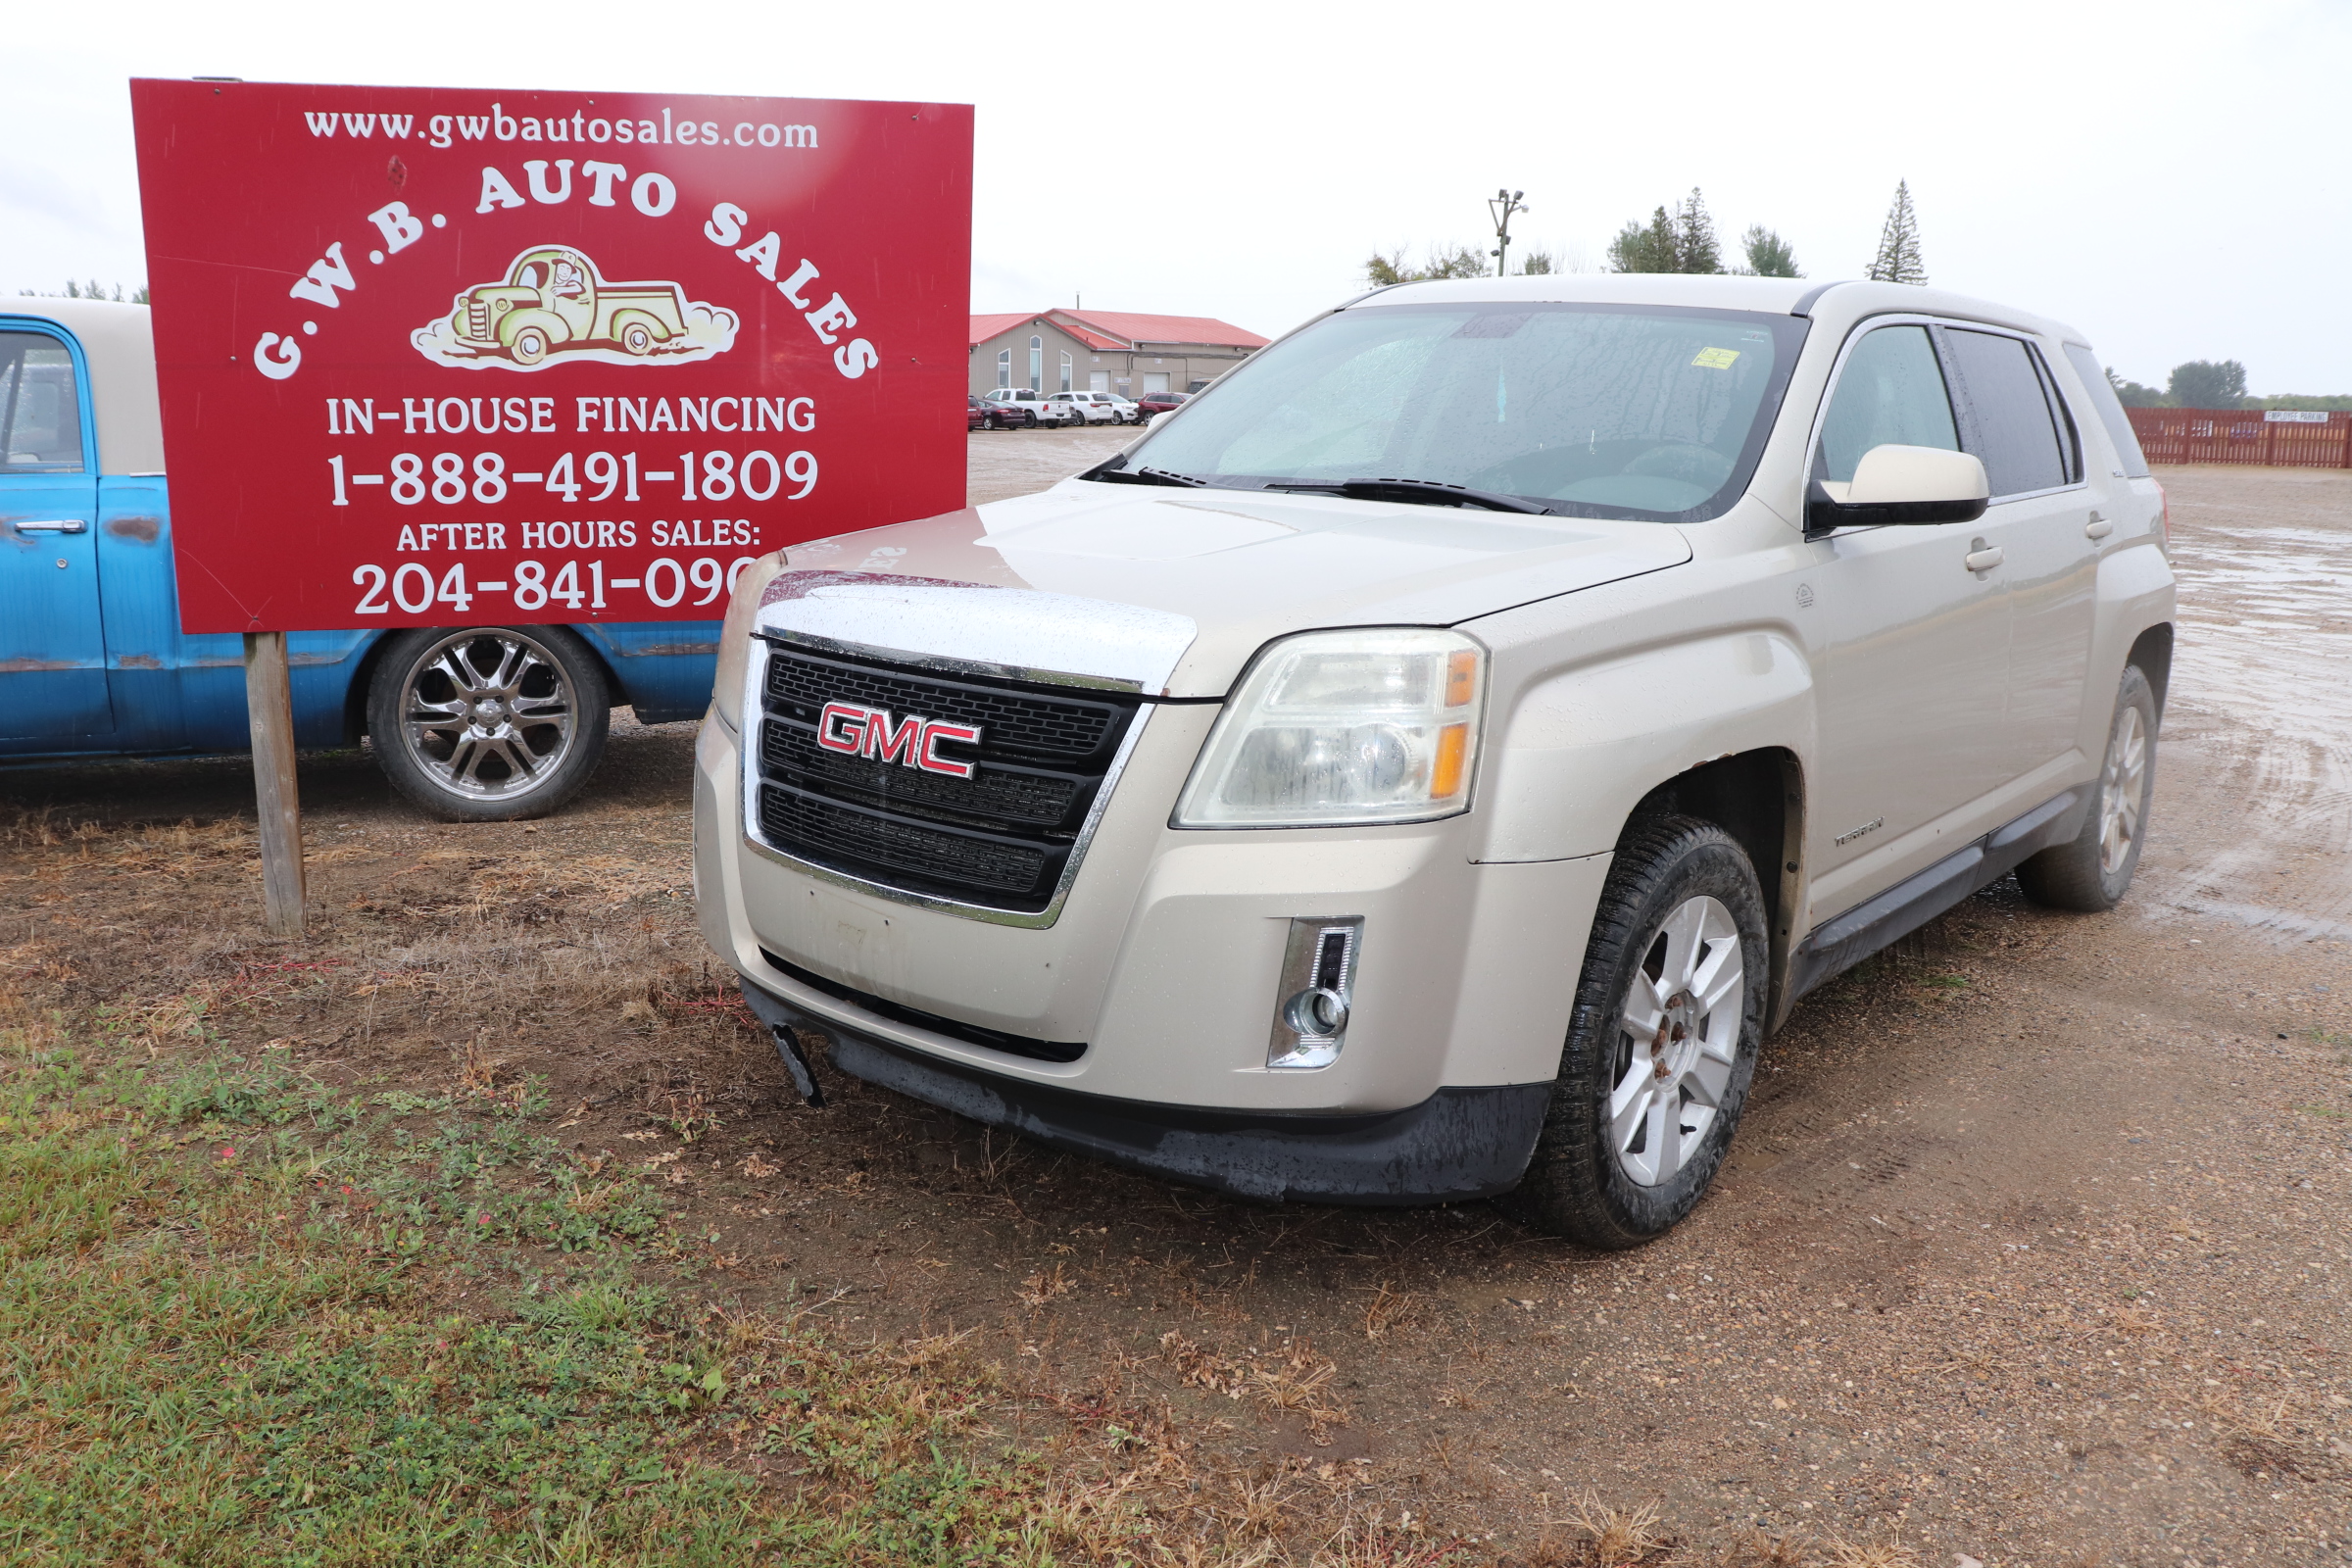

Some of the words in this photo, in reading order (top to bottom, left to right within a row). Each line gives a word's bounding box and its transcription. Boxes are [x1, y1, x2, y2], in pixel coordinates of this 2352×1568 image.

[305, 103, 818, 148] www.gwbautosales.com
[254, 202, 446, 379] G.W.B.
[476, 160, 676, 217] AUTO
[705, 203, 878, 379] SALES
[326, 397, 556, 434] IN-HOUSE
[576, 396, 814, 432] FINANCING
[2268, 412, 2298, 421] EMPLOYEE
[2300, 412, 2327, 421] PARKING
[328, 451, 817, 505] 1-888-491-1809
[397, 522, 506, 551] AFTER
[521, 521, 636, 549] HOURS
[652, 519, 760, 547] SALES:
[817, 702, 982, 781] GMC
